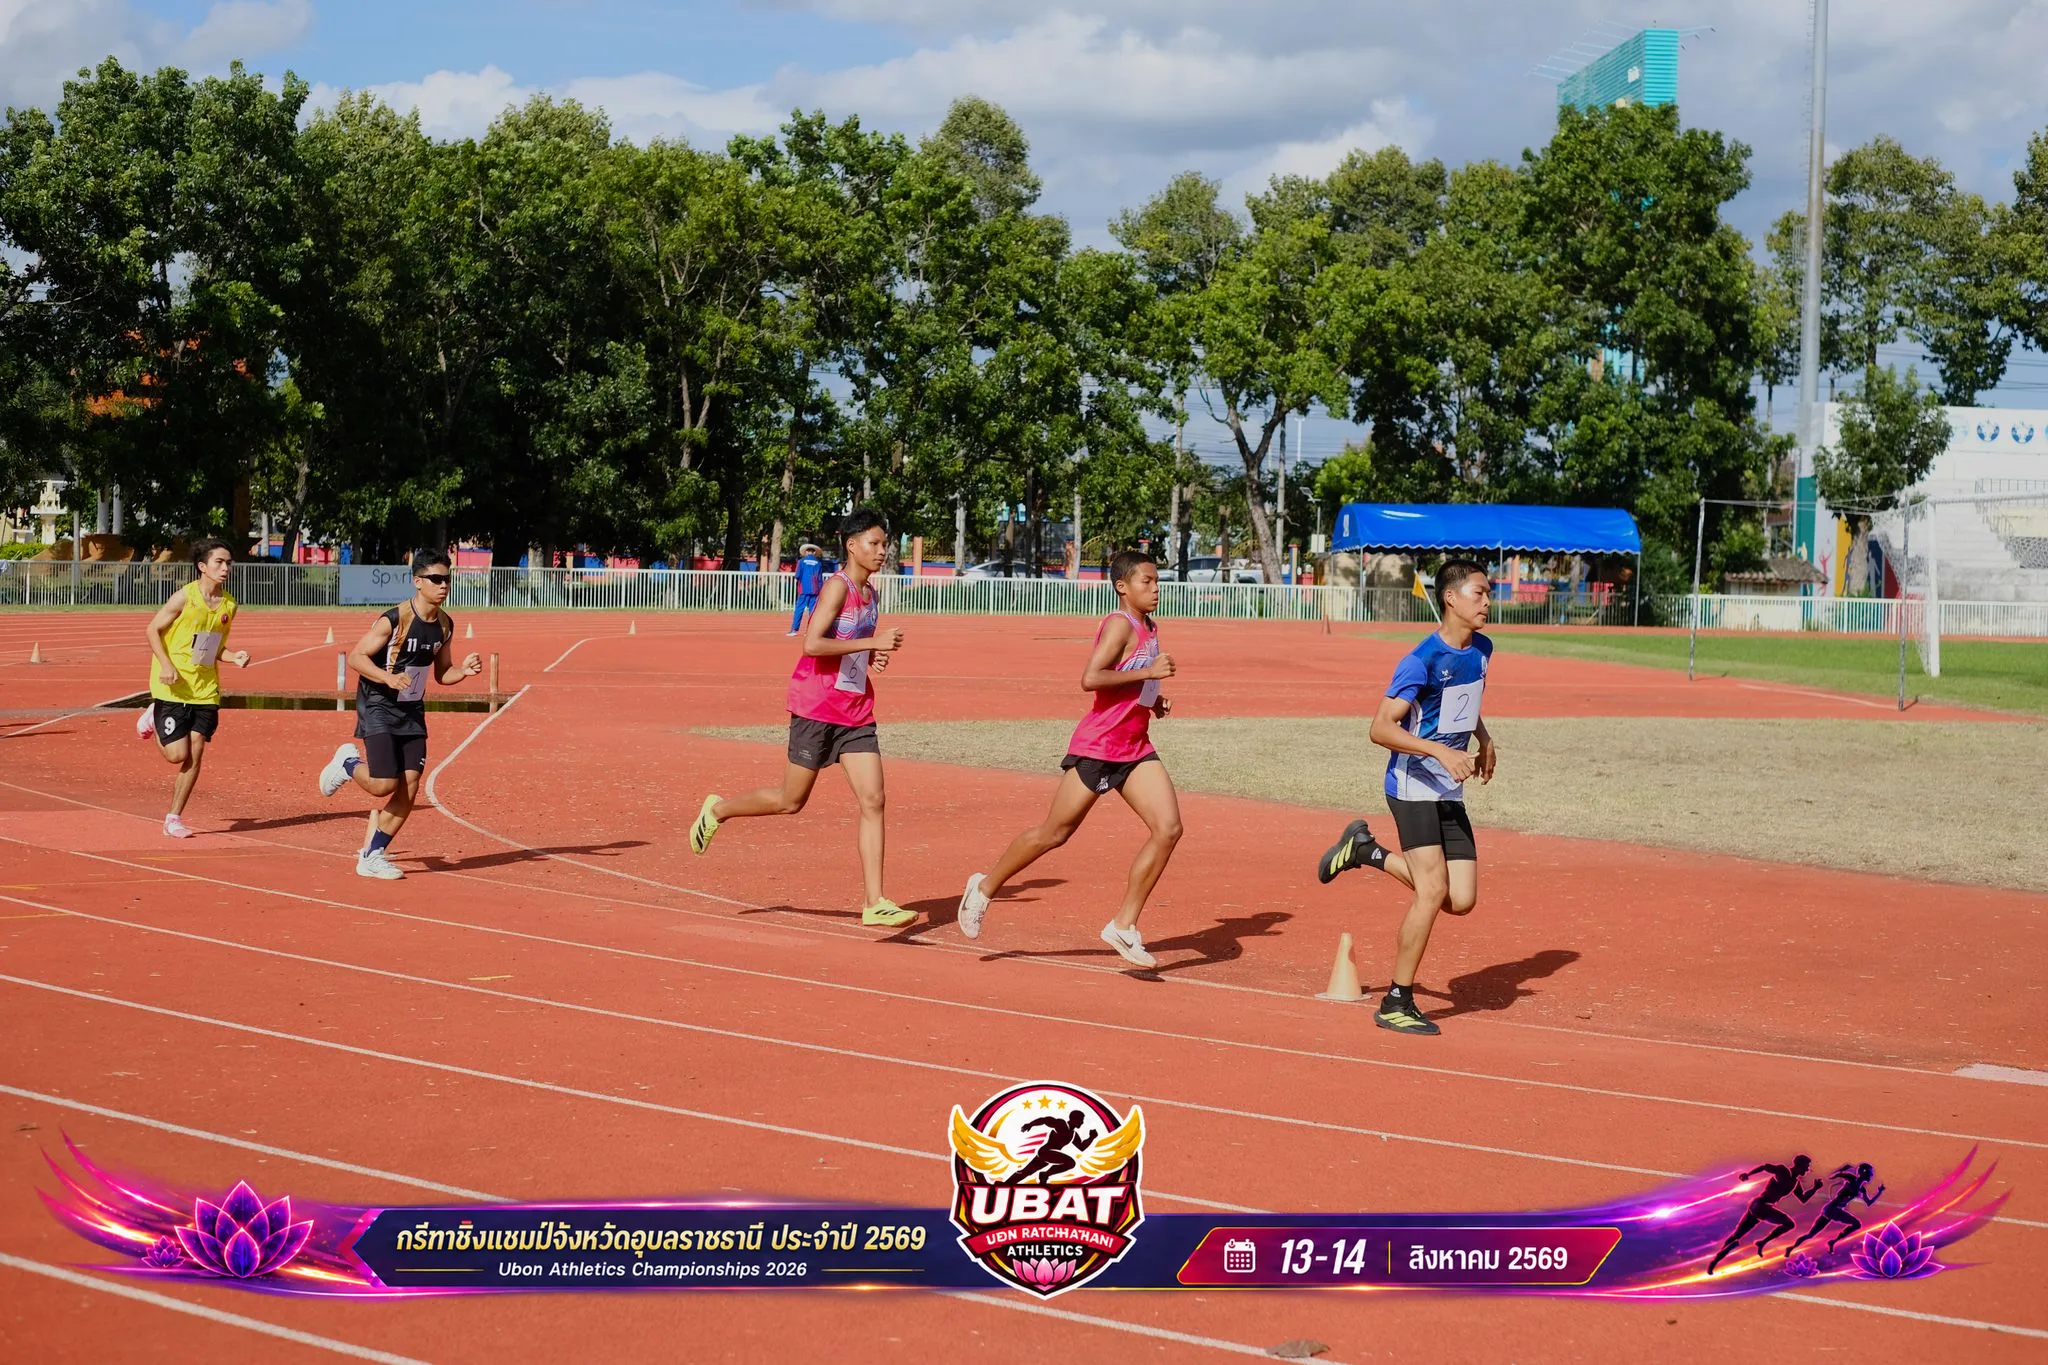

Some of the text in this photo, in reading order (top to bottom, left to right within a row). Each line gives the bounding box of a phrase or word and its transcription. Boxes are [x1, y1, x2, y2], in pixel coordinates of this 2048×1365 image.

[406, 638, 418, 652] 11
[409, 671, 421, 695] 1
[1453, 693, 1470, 722] 2
[164, 716, 176, 735] 9
